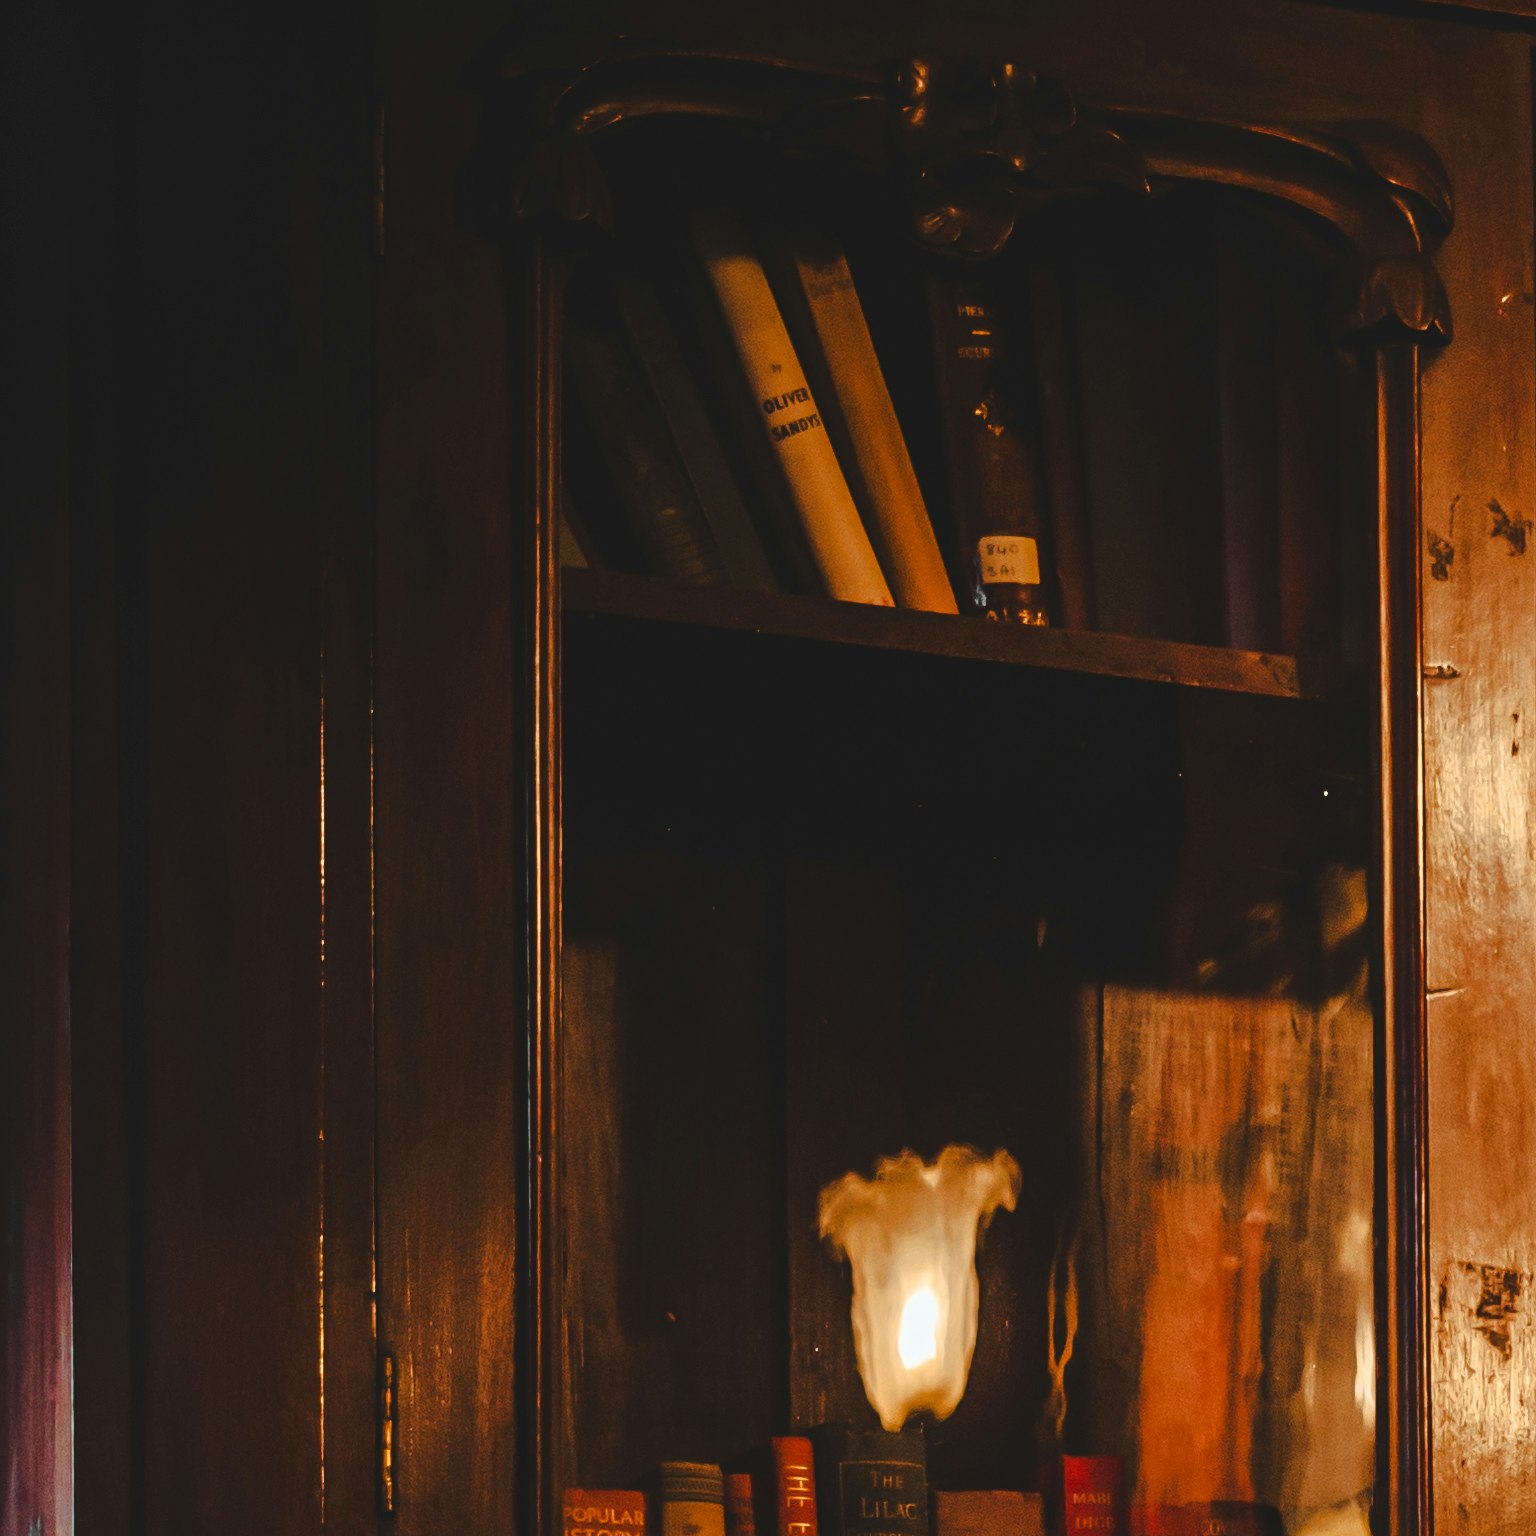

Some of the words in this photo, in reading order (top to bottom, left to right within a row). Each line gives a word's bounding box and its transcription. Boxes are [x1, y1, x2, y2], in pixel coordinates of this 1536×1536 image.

[764, 387, 809, 414] OLIVER
[772, 413, 821, 441] SANDYS
[786, 1465, 813, 1508] THE
[869, 1470, 904, 1489] THE
[563, 1506, 645, 1526] POPULAR
[860, 1498, 918, 1520] LILAC
